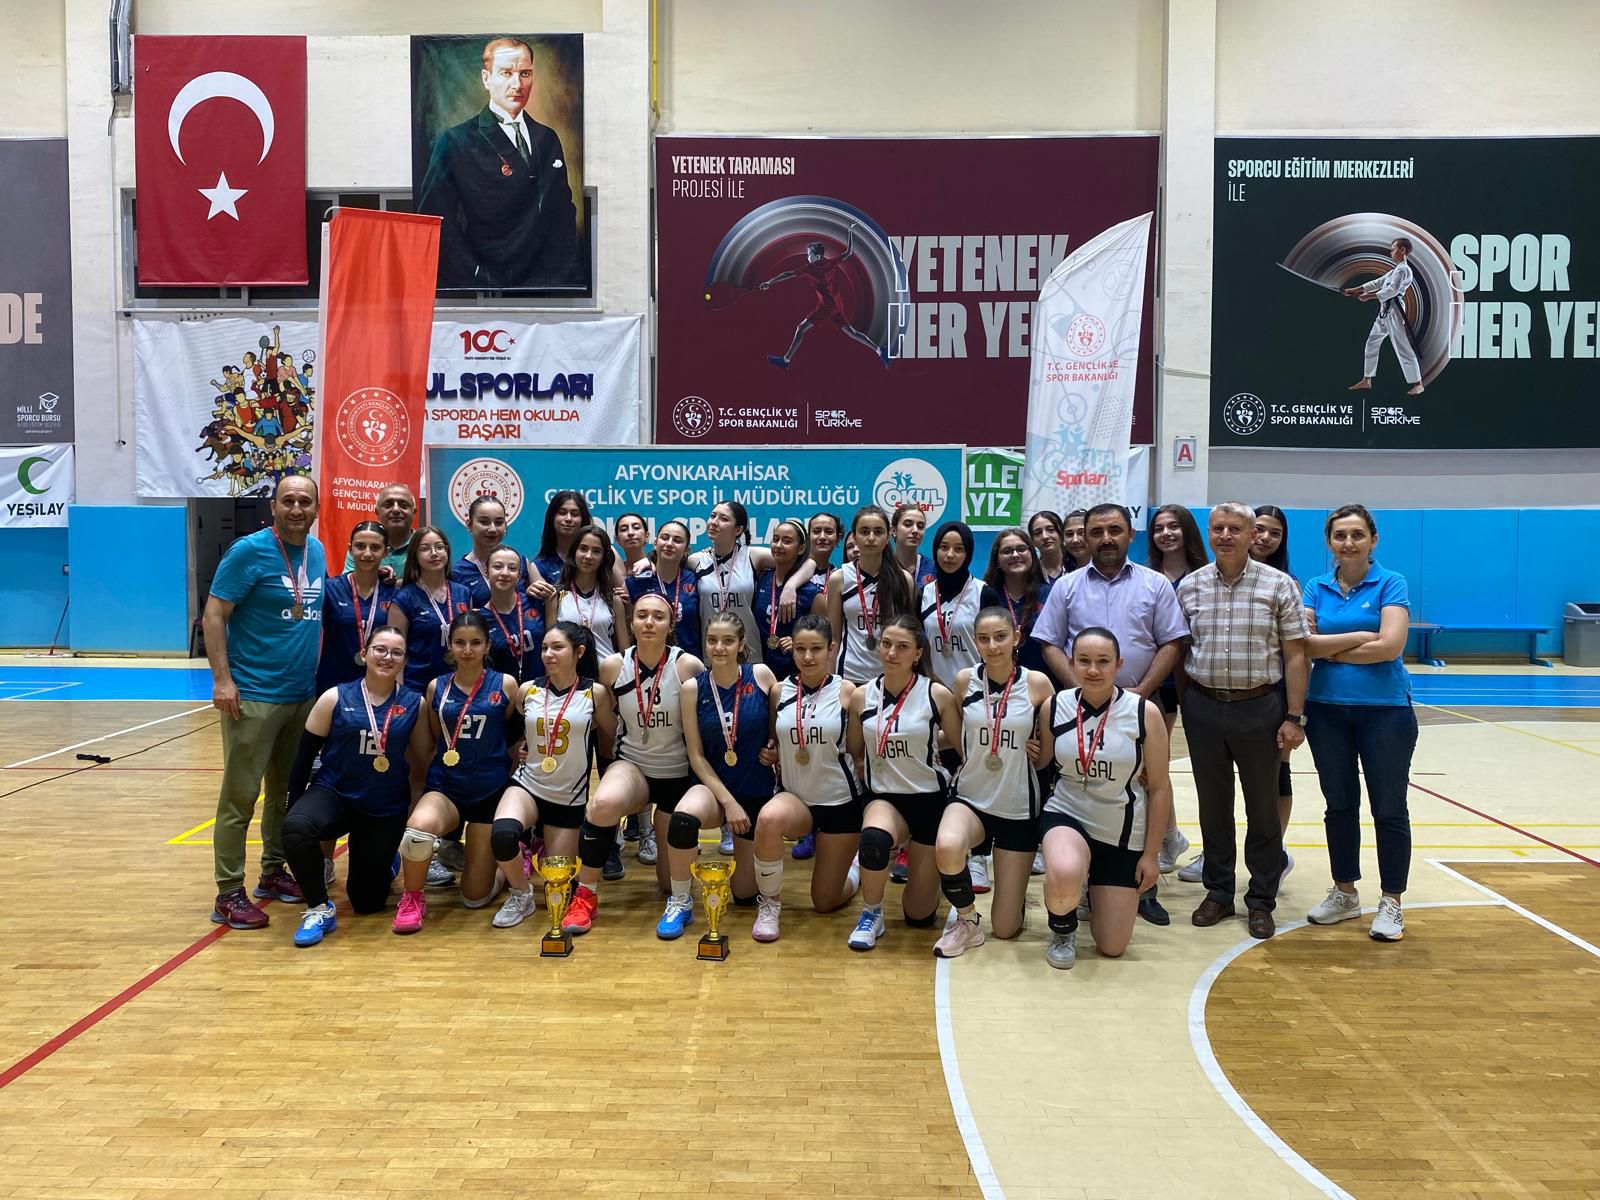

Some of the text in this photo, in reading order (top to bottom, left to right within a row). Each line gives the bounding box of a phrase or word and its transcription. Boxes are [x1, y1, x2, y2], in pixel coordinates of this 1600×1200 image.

[672, 156, 795, 175] YETENEK TARAMASI
[1228, 157, 1414, 179] SPORCU EĞİTİM MERKEZLERİ
[672, 177, 745, 199] PROJESİ İLE
[1228, 181, 1246, 201] İLE
[888, 234, 1069, 292] YETENEK
[1450, 233, 1571, 292] SPOR
[888, 302, 1038, 358] HER YE
[1449, 301, 1600, 359] HER YE
[1066, 360, 1108, 373] GENÇLİK
[426, 373, 594, 401] UL SPORLARI
[1046, 373, 1069, 382] SPOR
[17, 414, 61, 422] SPORCU BURSU
[431, 408, 580, 422] SPORDA HEM OKULDA
[718, 406, 798, 418] T.C. GENÇLİK VE
[1270, 403, 1353, 416] T.C. GENÇLİK VE
[718, 417, 798, 428] SPOR BAKANLIĞI
[815, 417, 862, 428] TÜRKİYE
[1270, 414, 1353, 425] SPOR BAKANLIĞI
[1371, 414, 1421, 425] TÜRKİYE
[458, 423, 521, 442] BAŞARI
[1177, 443, 1193, 462] A
[615, 461, 790, 481] AFYONKARAHİSAR
[332, 489, 372, 501] GENÇLİK
[544, 486, 628, 508] GÇLİK
[630, 490, 653, 505] VE
[658, 489, 707, 505] SPOR
[734, 484, 860, 506] MÜDÜRLÜĞÜ
[966, 492, 1011, 517] YIZ
[711, 592, 744, 609] OAL
[281, 606, 322, 621] adas
[934, 635, 968, 653] OAL
[457, 714, 488, 740] 27
[979, 727, 1019, 750] OAL
